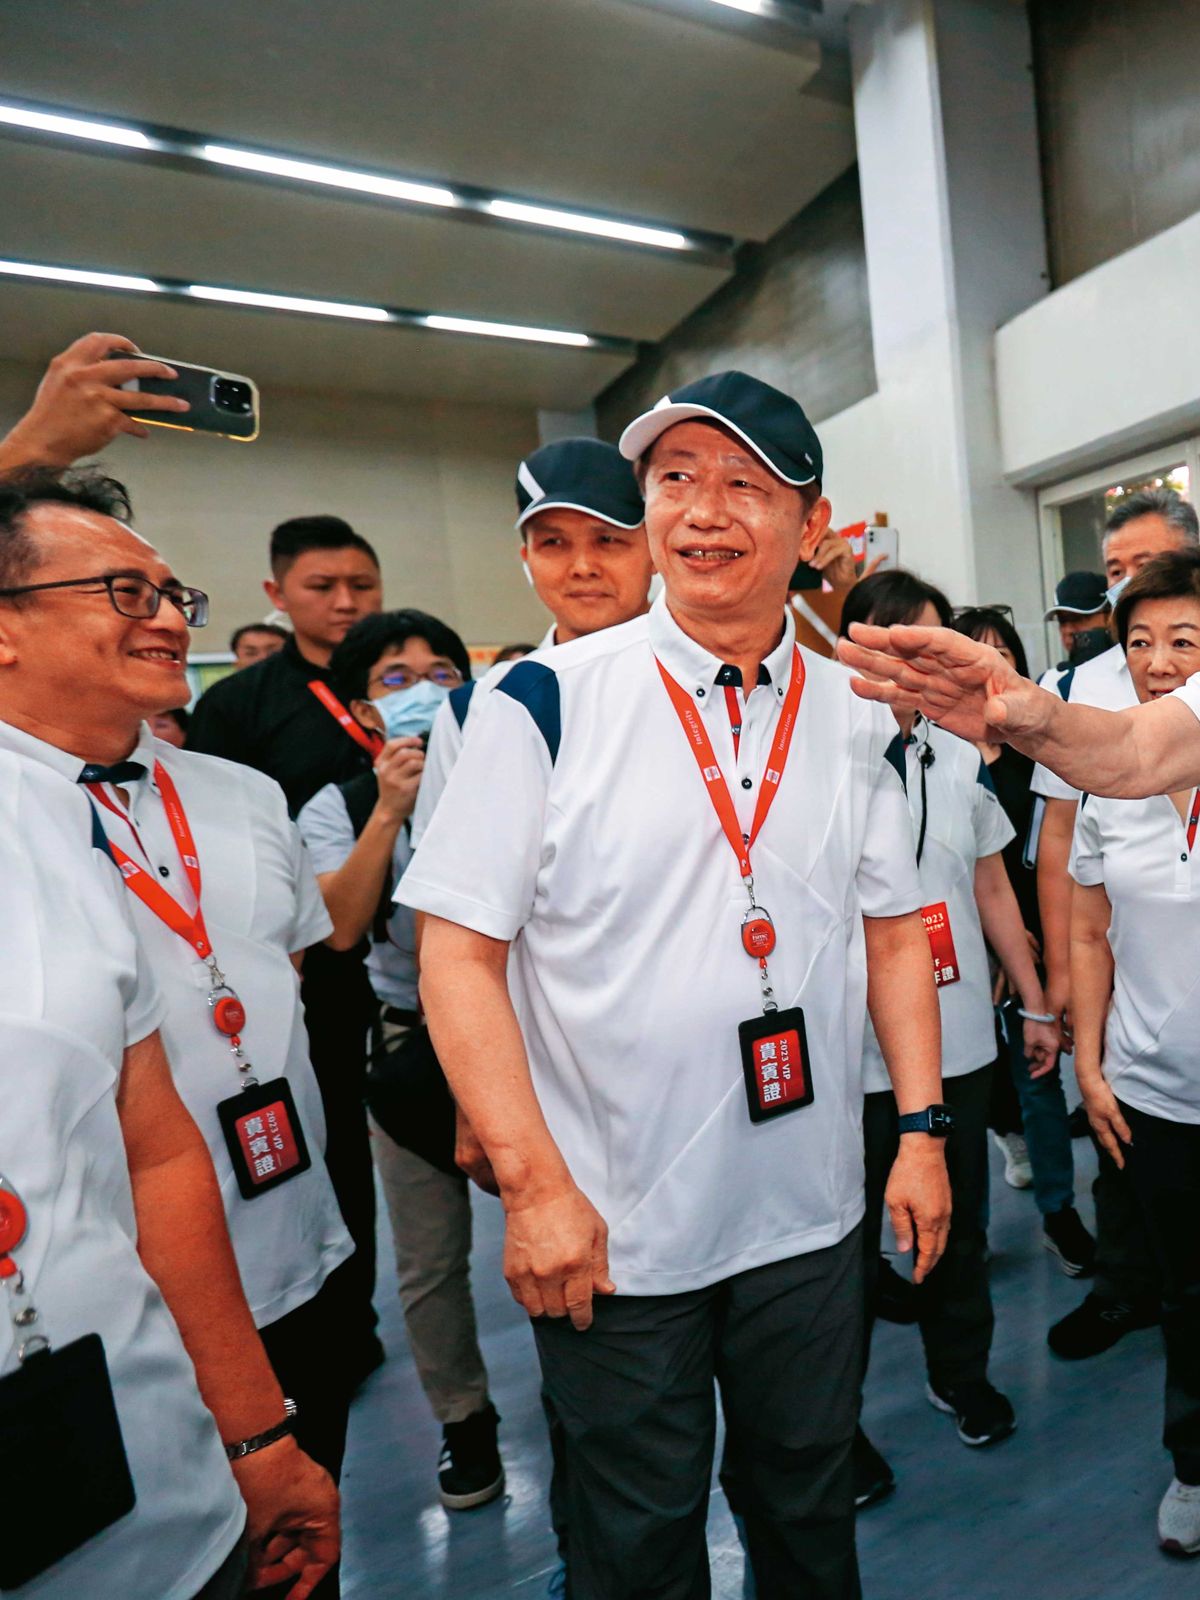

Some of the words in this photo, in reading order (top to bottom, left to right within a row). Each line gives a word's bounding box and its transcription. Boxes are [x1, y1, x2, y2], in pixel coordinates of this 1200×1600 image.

[780, 1039, 789, 1062] 2023
[760, 1042, 782, 1103] 貴賓證
[782, 1063, 791, 1080] VIP
[244, 1116, 277, 1177] 貴賓證
[266, 1110, 279, 1134] 2023
[273, 1134, 284, 1150] VIP
